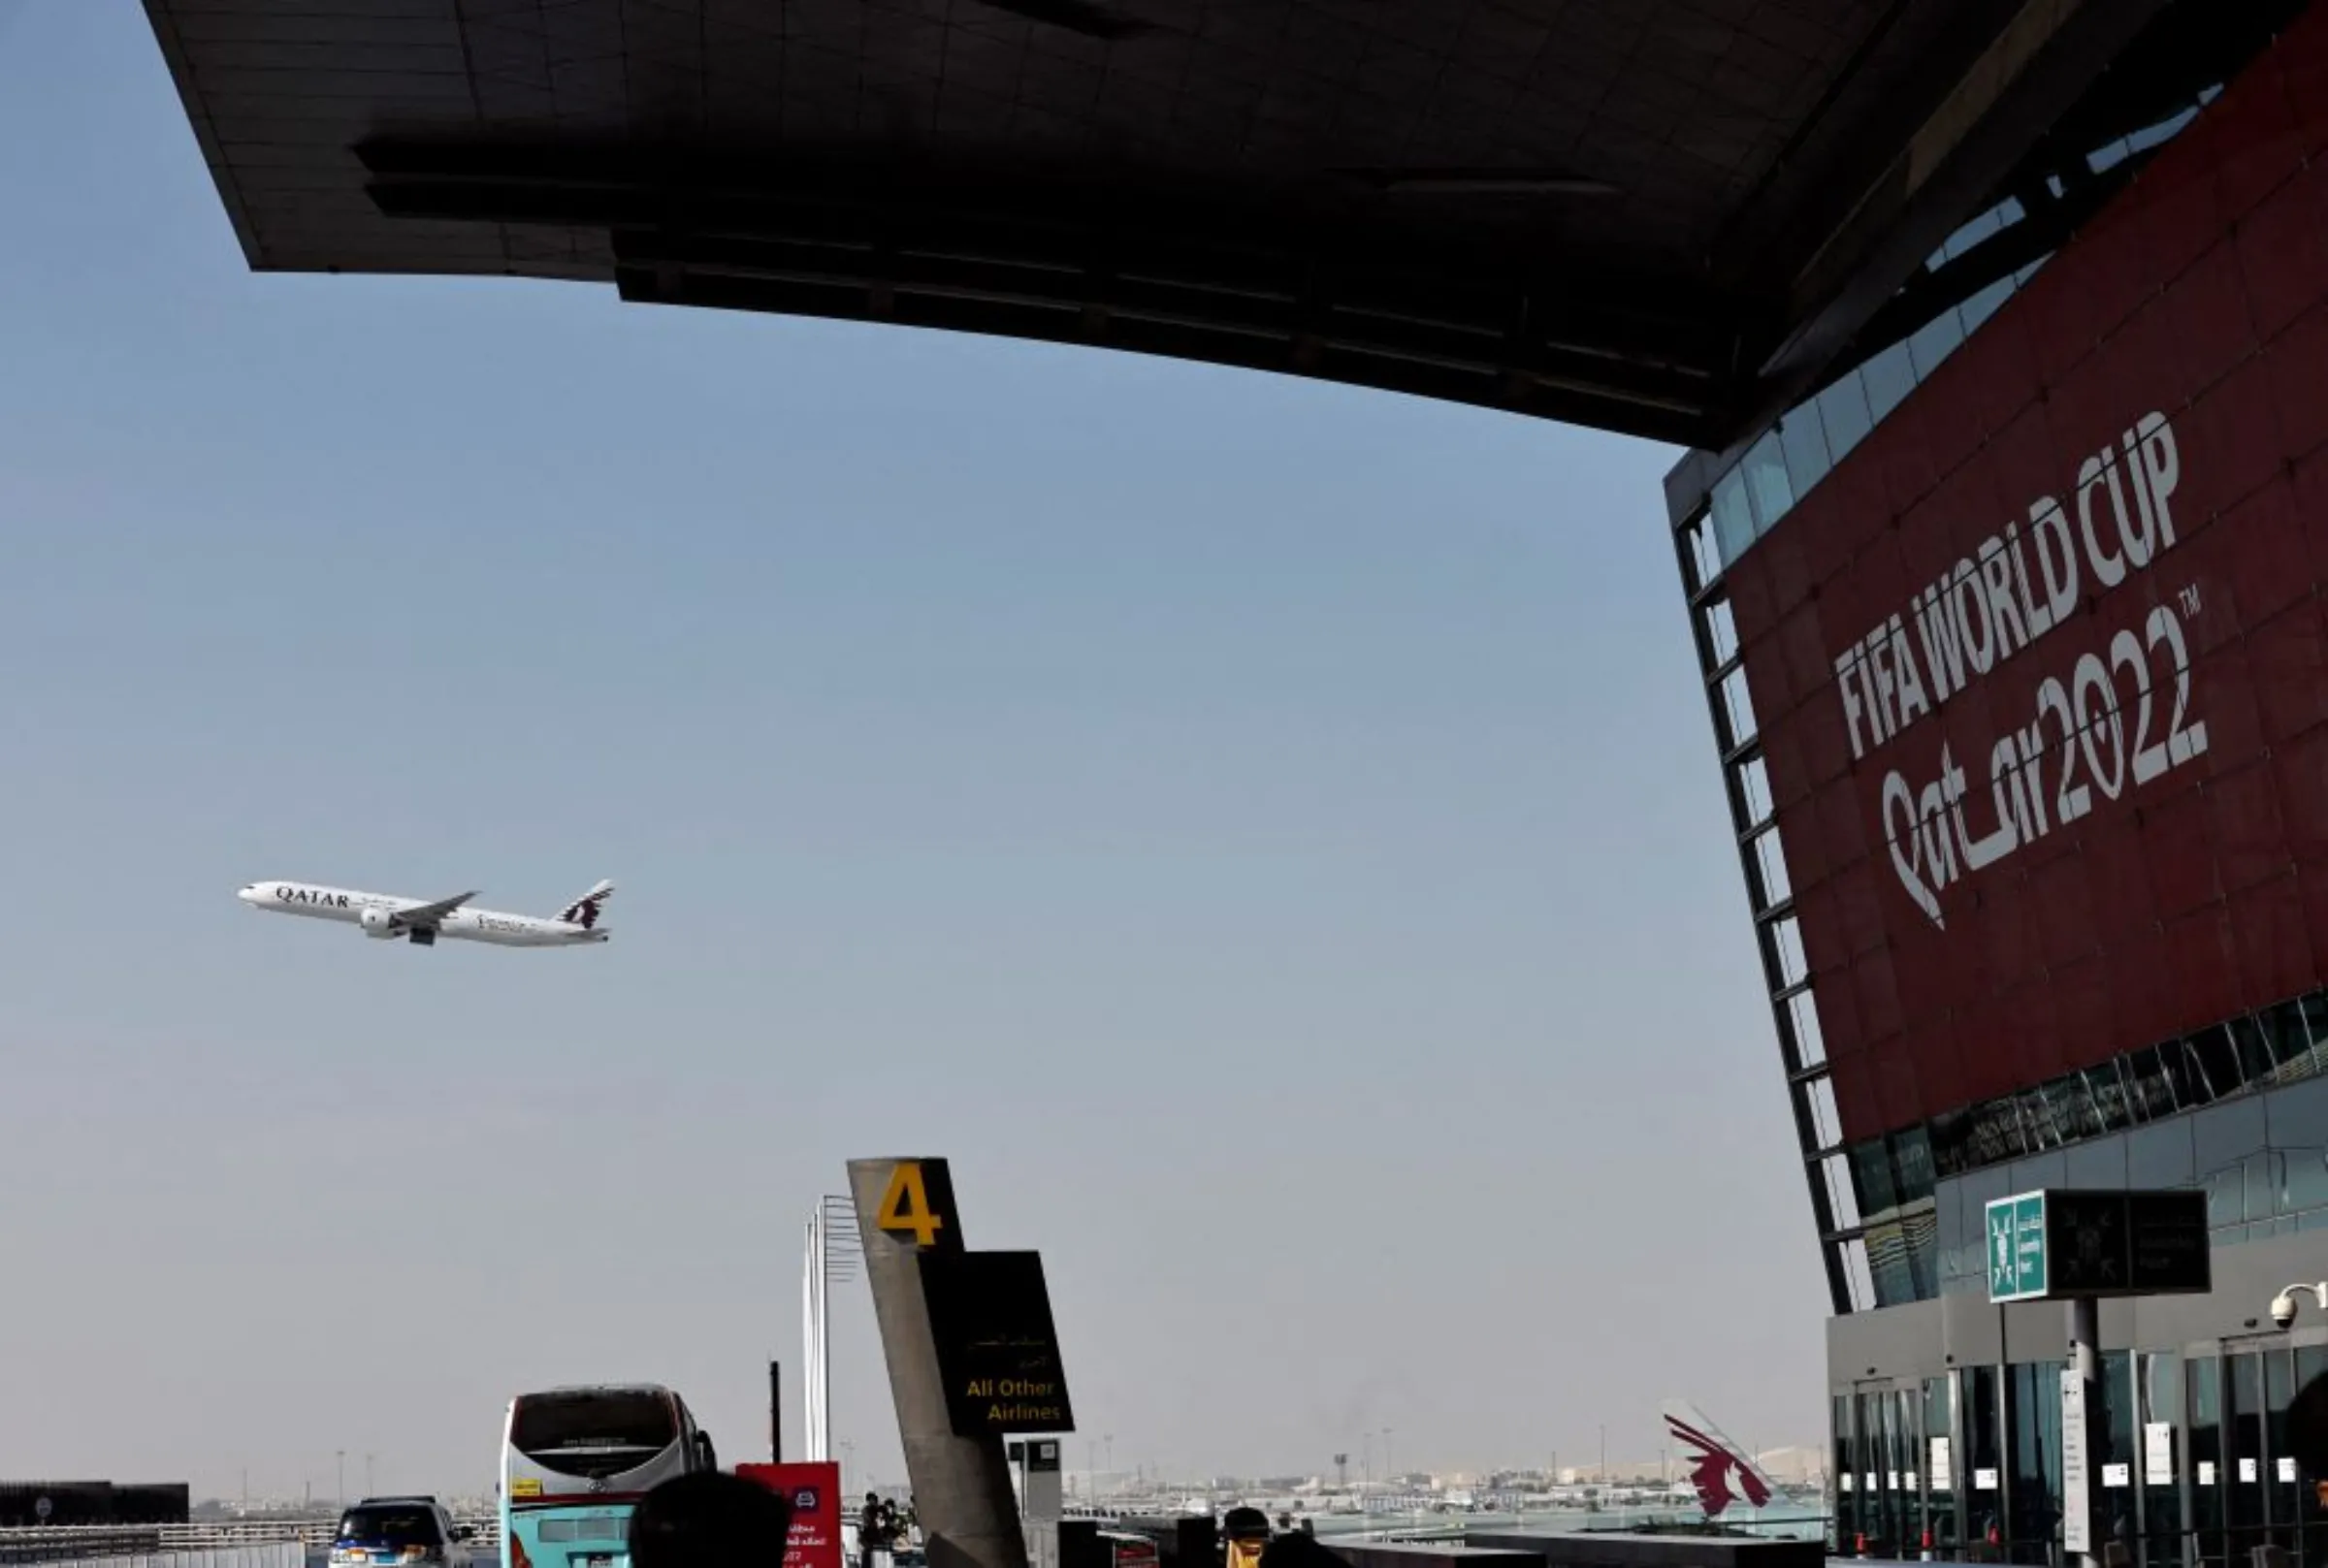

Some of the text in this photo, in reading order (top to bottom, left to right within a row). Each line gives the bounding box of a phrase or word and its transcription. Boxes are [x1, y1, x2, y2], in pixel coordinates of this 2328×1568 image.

[1835, 411, 2180, 758] FIFA WORLD CUP
[276, 886, 350, 909] QATAR
[879, 1164, 943, 1246] 4
[966, 1378, 1055, 1397] All Other
[987, 1402, 1061, 1422] Airlines
